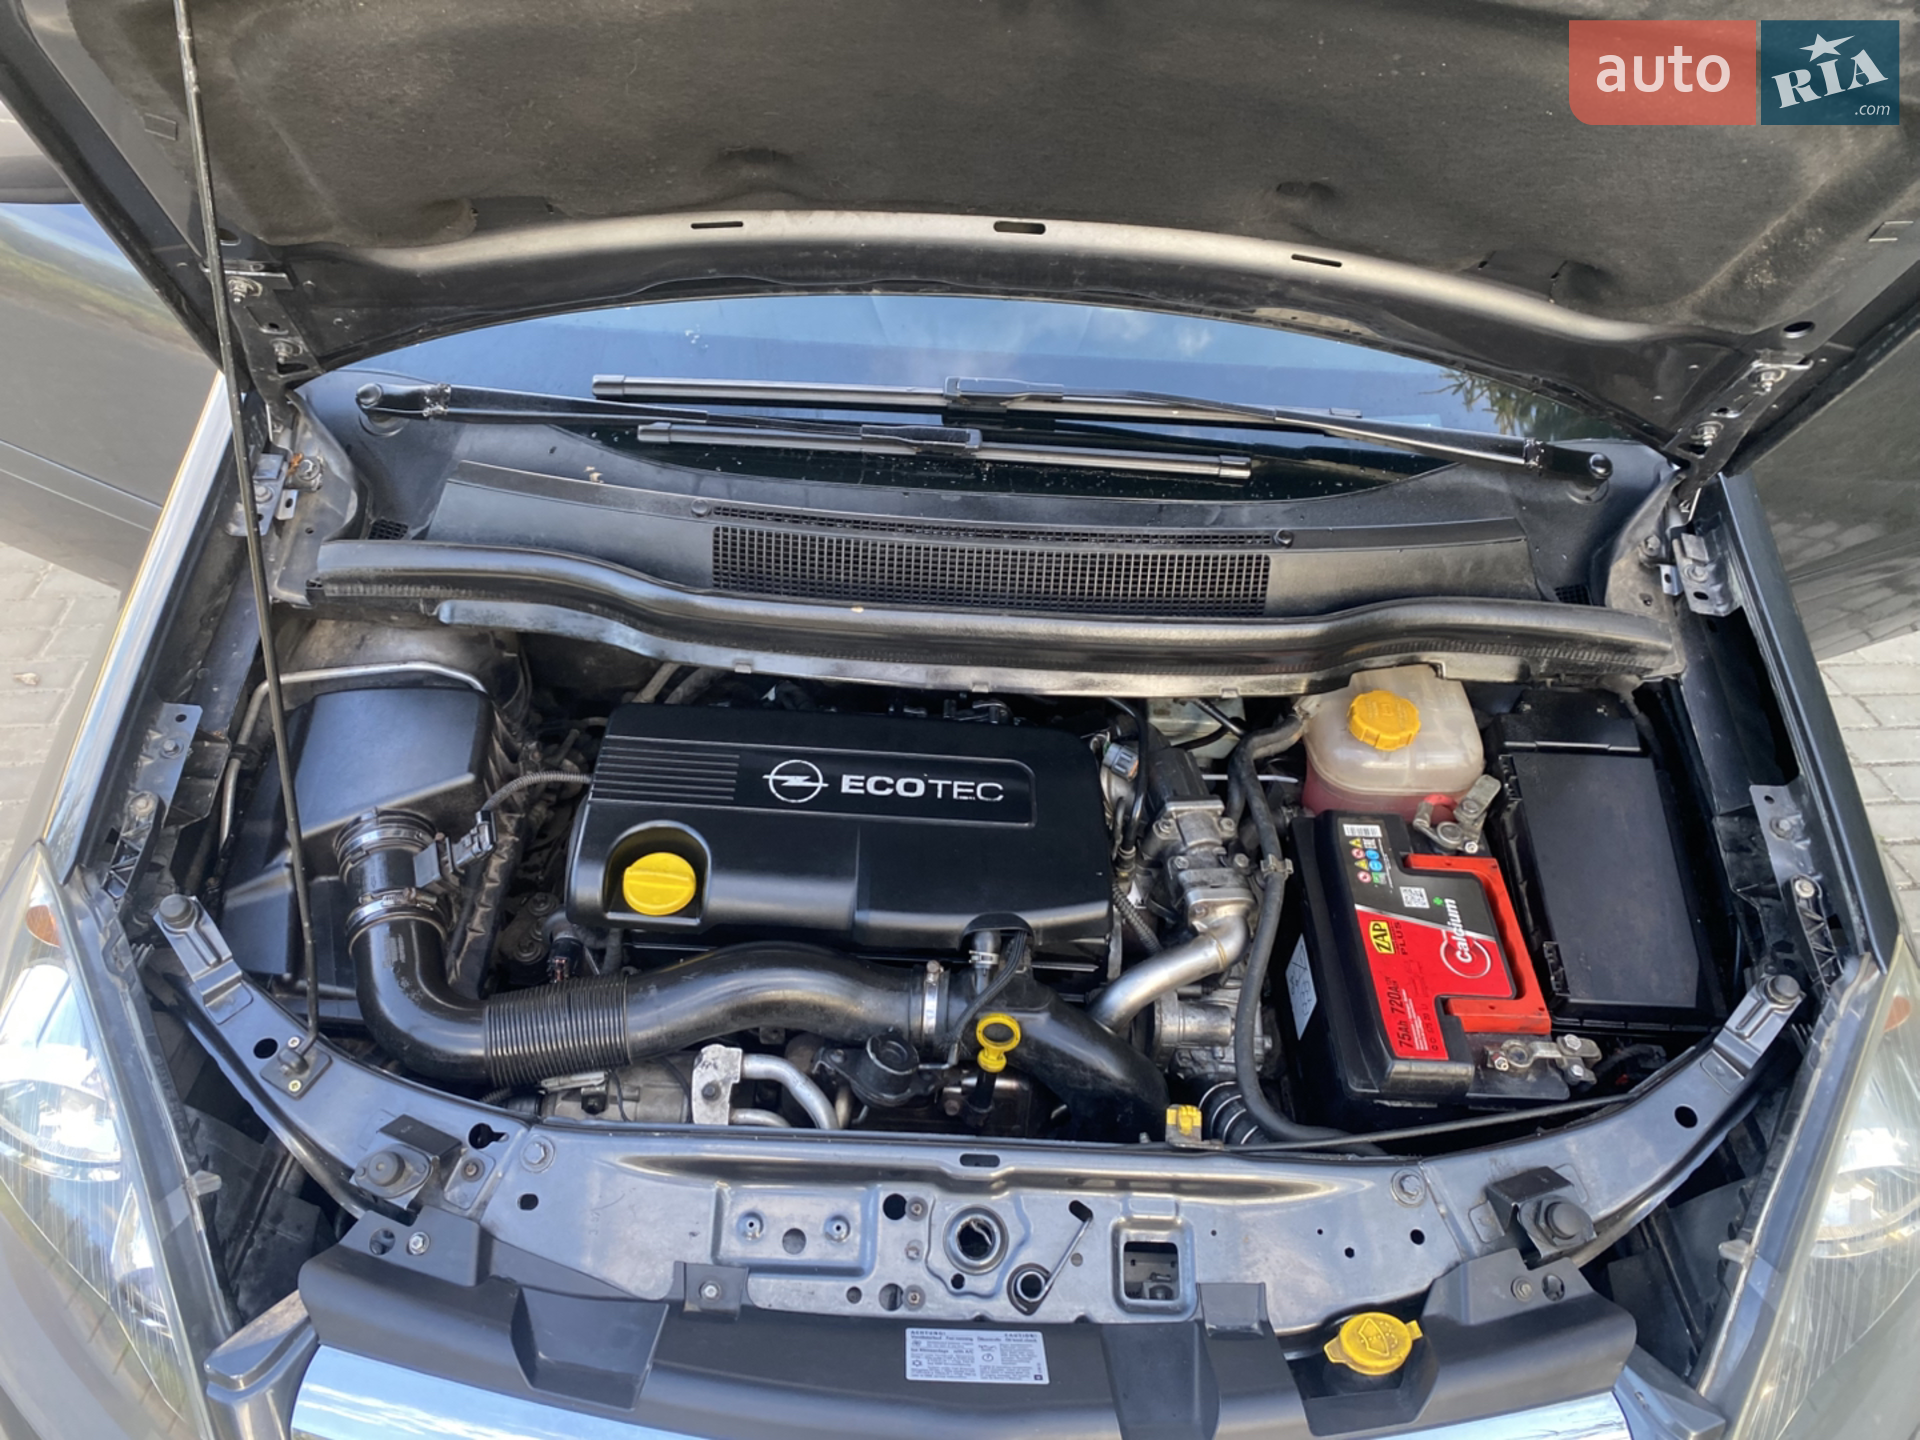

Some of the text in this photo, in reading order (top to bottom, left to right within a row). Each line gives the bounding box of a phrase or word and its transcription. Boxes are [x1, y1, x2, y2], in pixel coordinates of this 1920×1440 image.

[841, 774, 1004, 801] ECOTEC
[1372, 922, 1392, 952] ZAP
[1395, 922, 1408, 955] PLUS
[1444, 898, 1472, 963] Calcium
[1397, 1020, 1414, 1048] 75Ah
